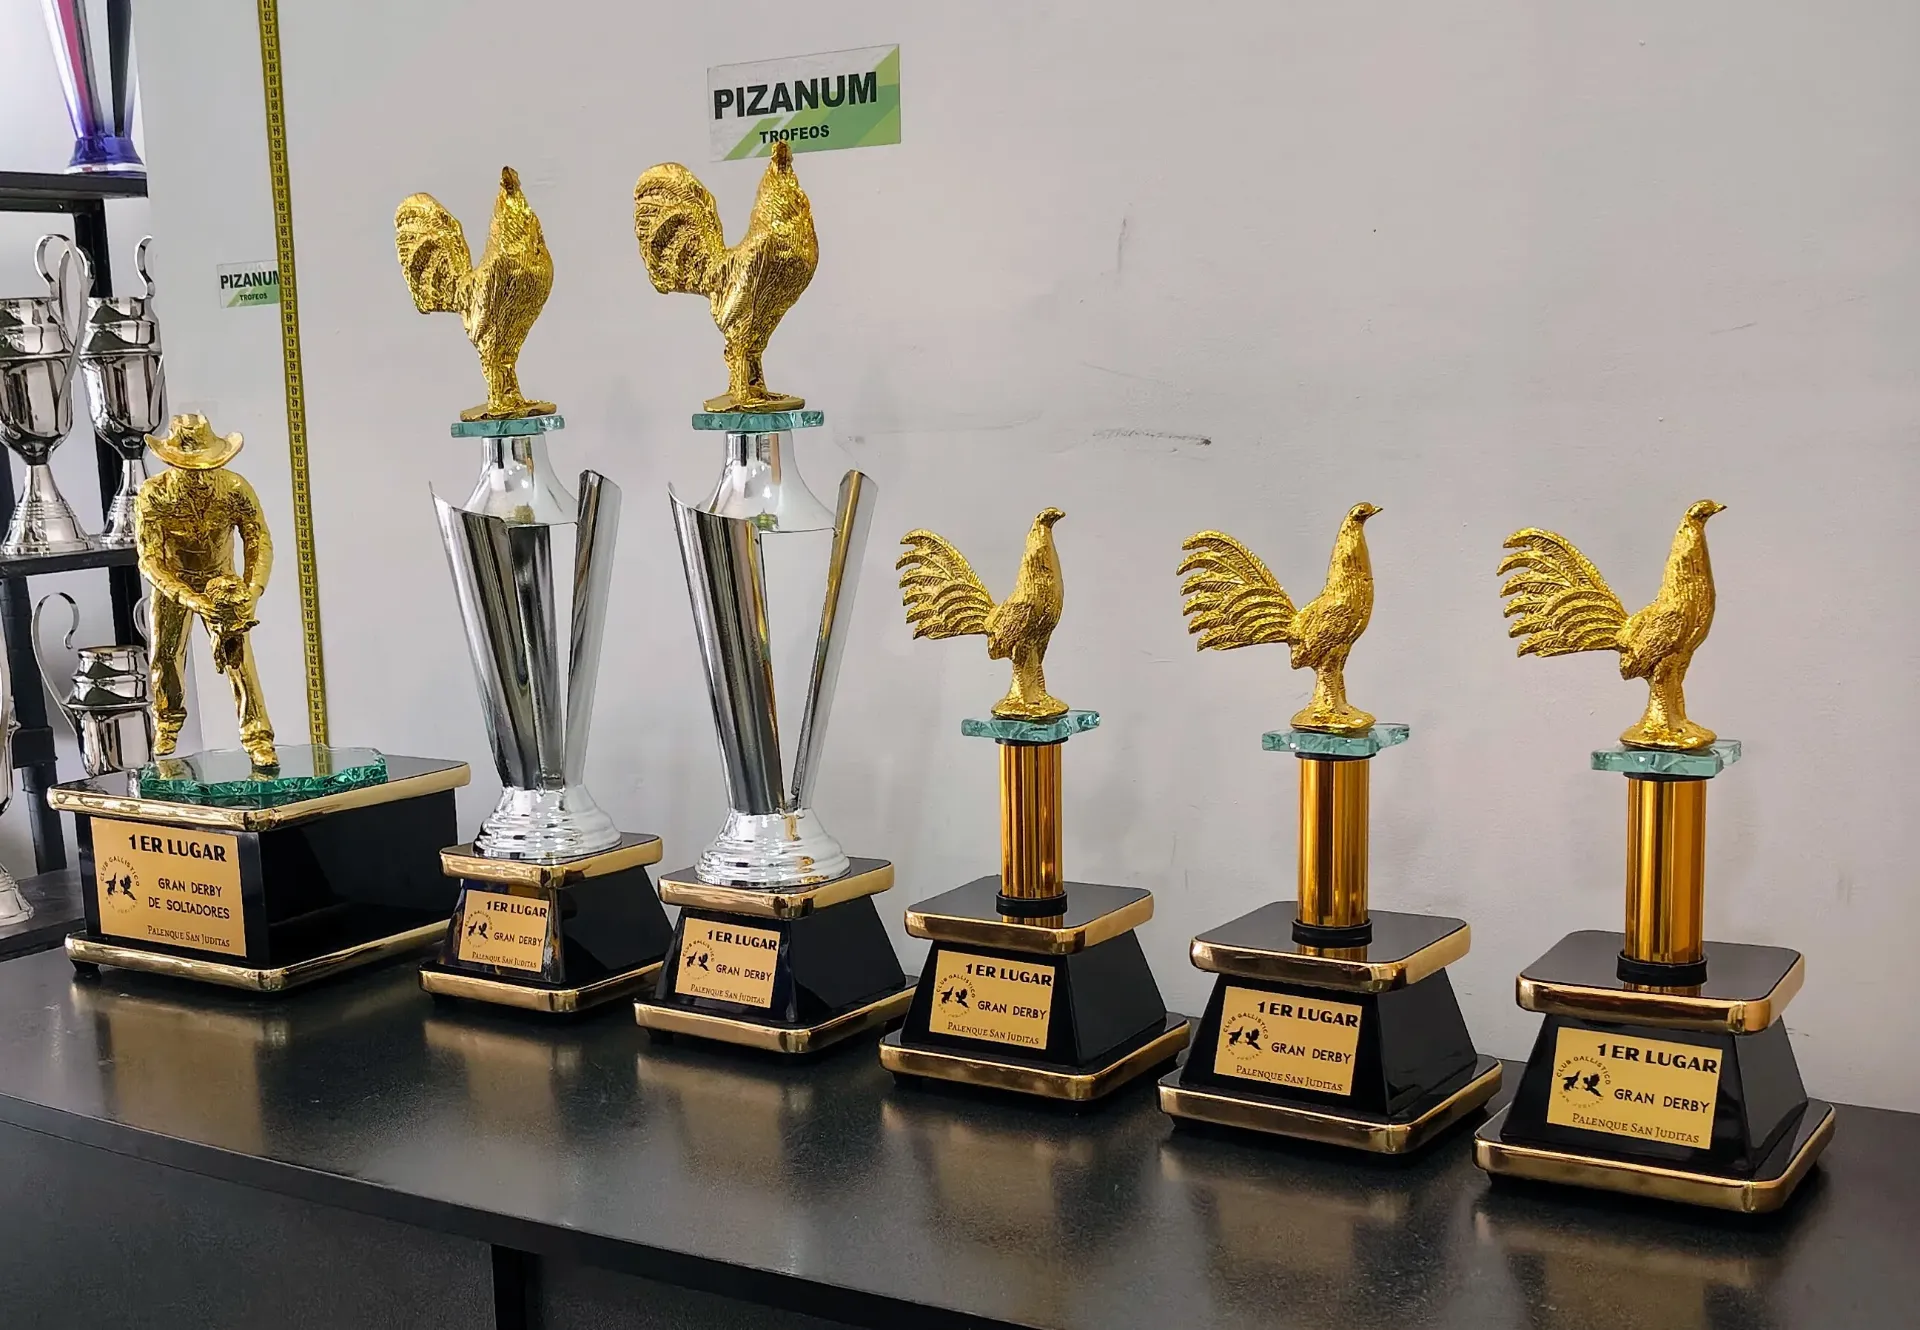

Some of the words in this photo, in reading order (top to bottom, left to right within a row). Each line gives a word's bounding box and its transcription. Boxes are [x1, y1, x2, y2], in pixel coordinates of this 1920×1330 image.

[714, 71, 877, 120] PIZANUM
[759, 125, 830, 144] TROFEOS
[240, 293, 268, 301] TROFEOS
[168, 839, 226, 862] LUGAR
[158, 878, 186, 892] GRAN
[192, 882, 222, 897] DERBY
[149, 897, 160, 908] DE
[167, 900, 229, 919] SOLTADORES
[511, 904, 547, 918] LUGAR
[494, 932, 514, 942] GRAN
[519, 936, 542, 946] DERBY
[736, 935, 777, 950] LUGAR
[716, 964, 740, 975] GRAN
[744, 969, 772, 981] DERBY
[1000, 968, 1052, 986] LUGAR
[978, 1001, 1007, 1013] GRAN
[1013, 1006, 1047, 1020] DERBY
[1298, 1007, 1358, 1028] LUGAR
[1272, 1042, 1305, 1056] GRAN
[1312, 1049, 1351, 1064] DERBY
[1645, 1050, 1717, 1074] LUGAR
[1557, 1060, 1572, 1077] CLUB
[1614, 1089, 1654, 1105] GRAN
[1663, 1096, 1710, 1113] DERBY
